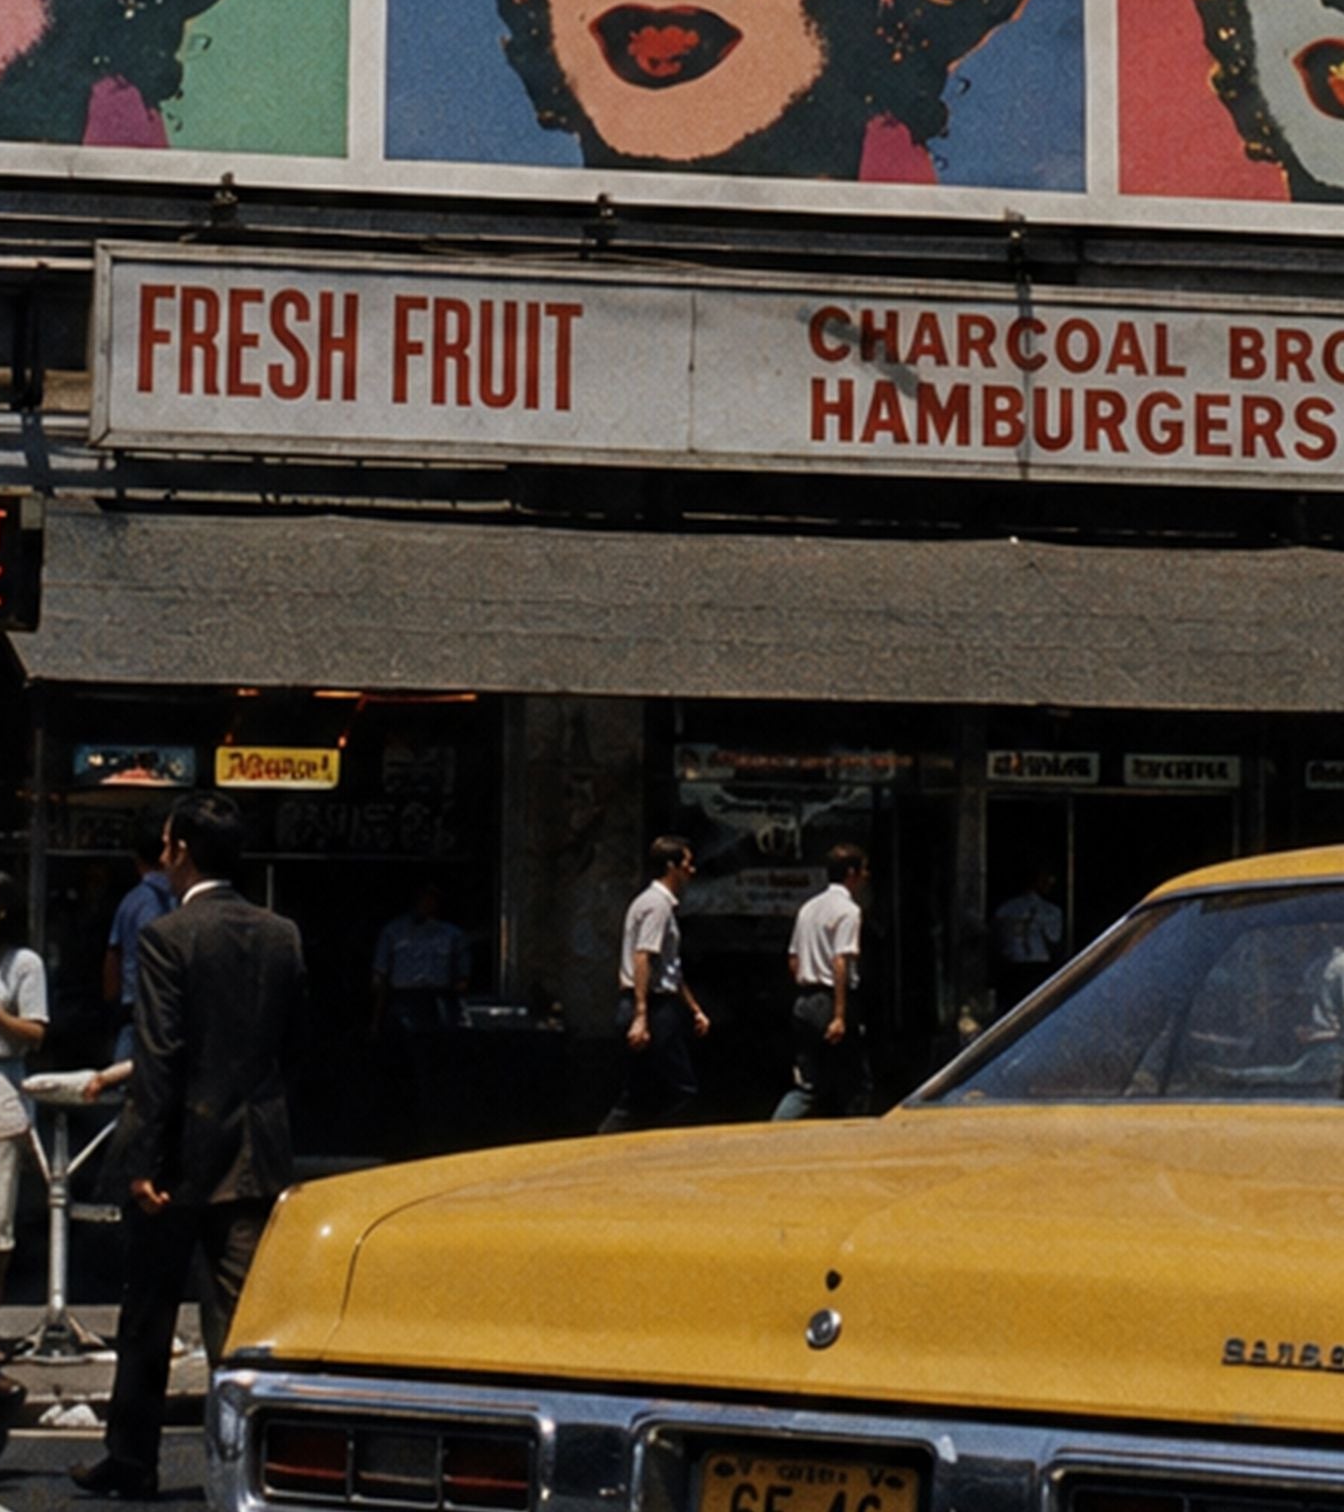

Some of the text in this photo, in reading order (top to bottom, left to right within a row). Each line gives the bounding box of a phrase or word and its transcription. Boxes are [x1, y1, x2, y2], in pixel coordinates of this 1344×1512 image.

[136, 283, 583, 411] FRESH FRUIT
[808, 306, 1187, 378] CHARCOAL
[809, 377, 1338, 460] HAMBURGERS
